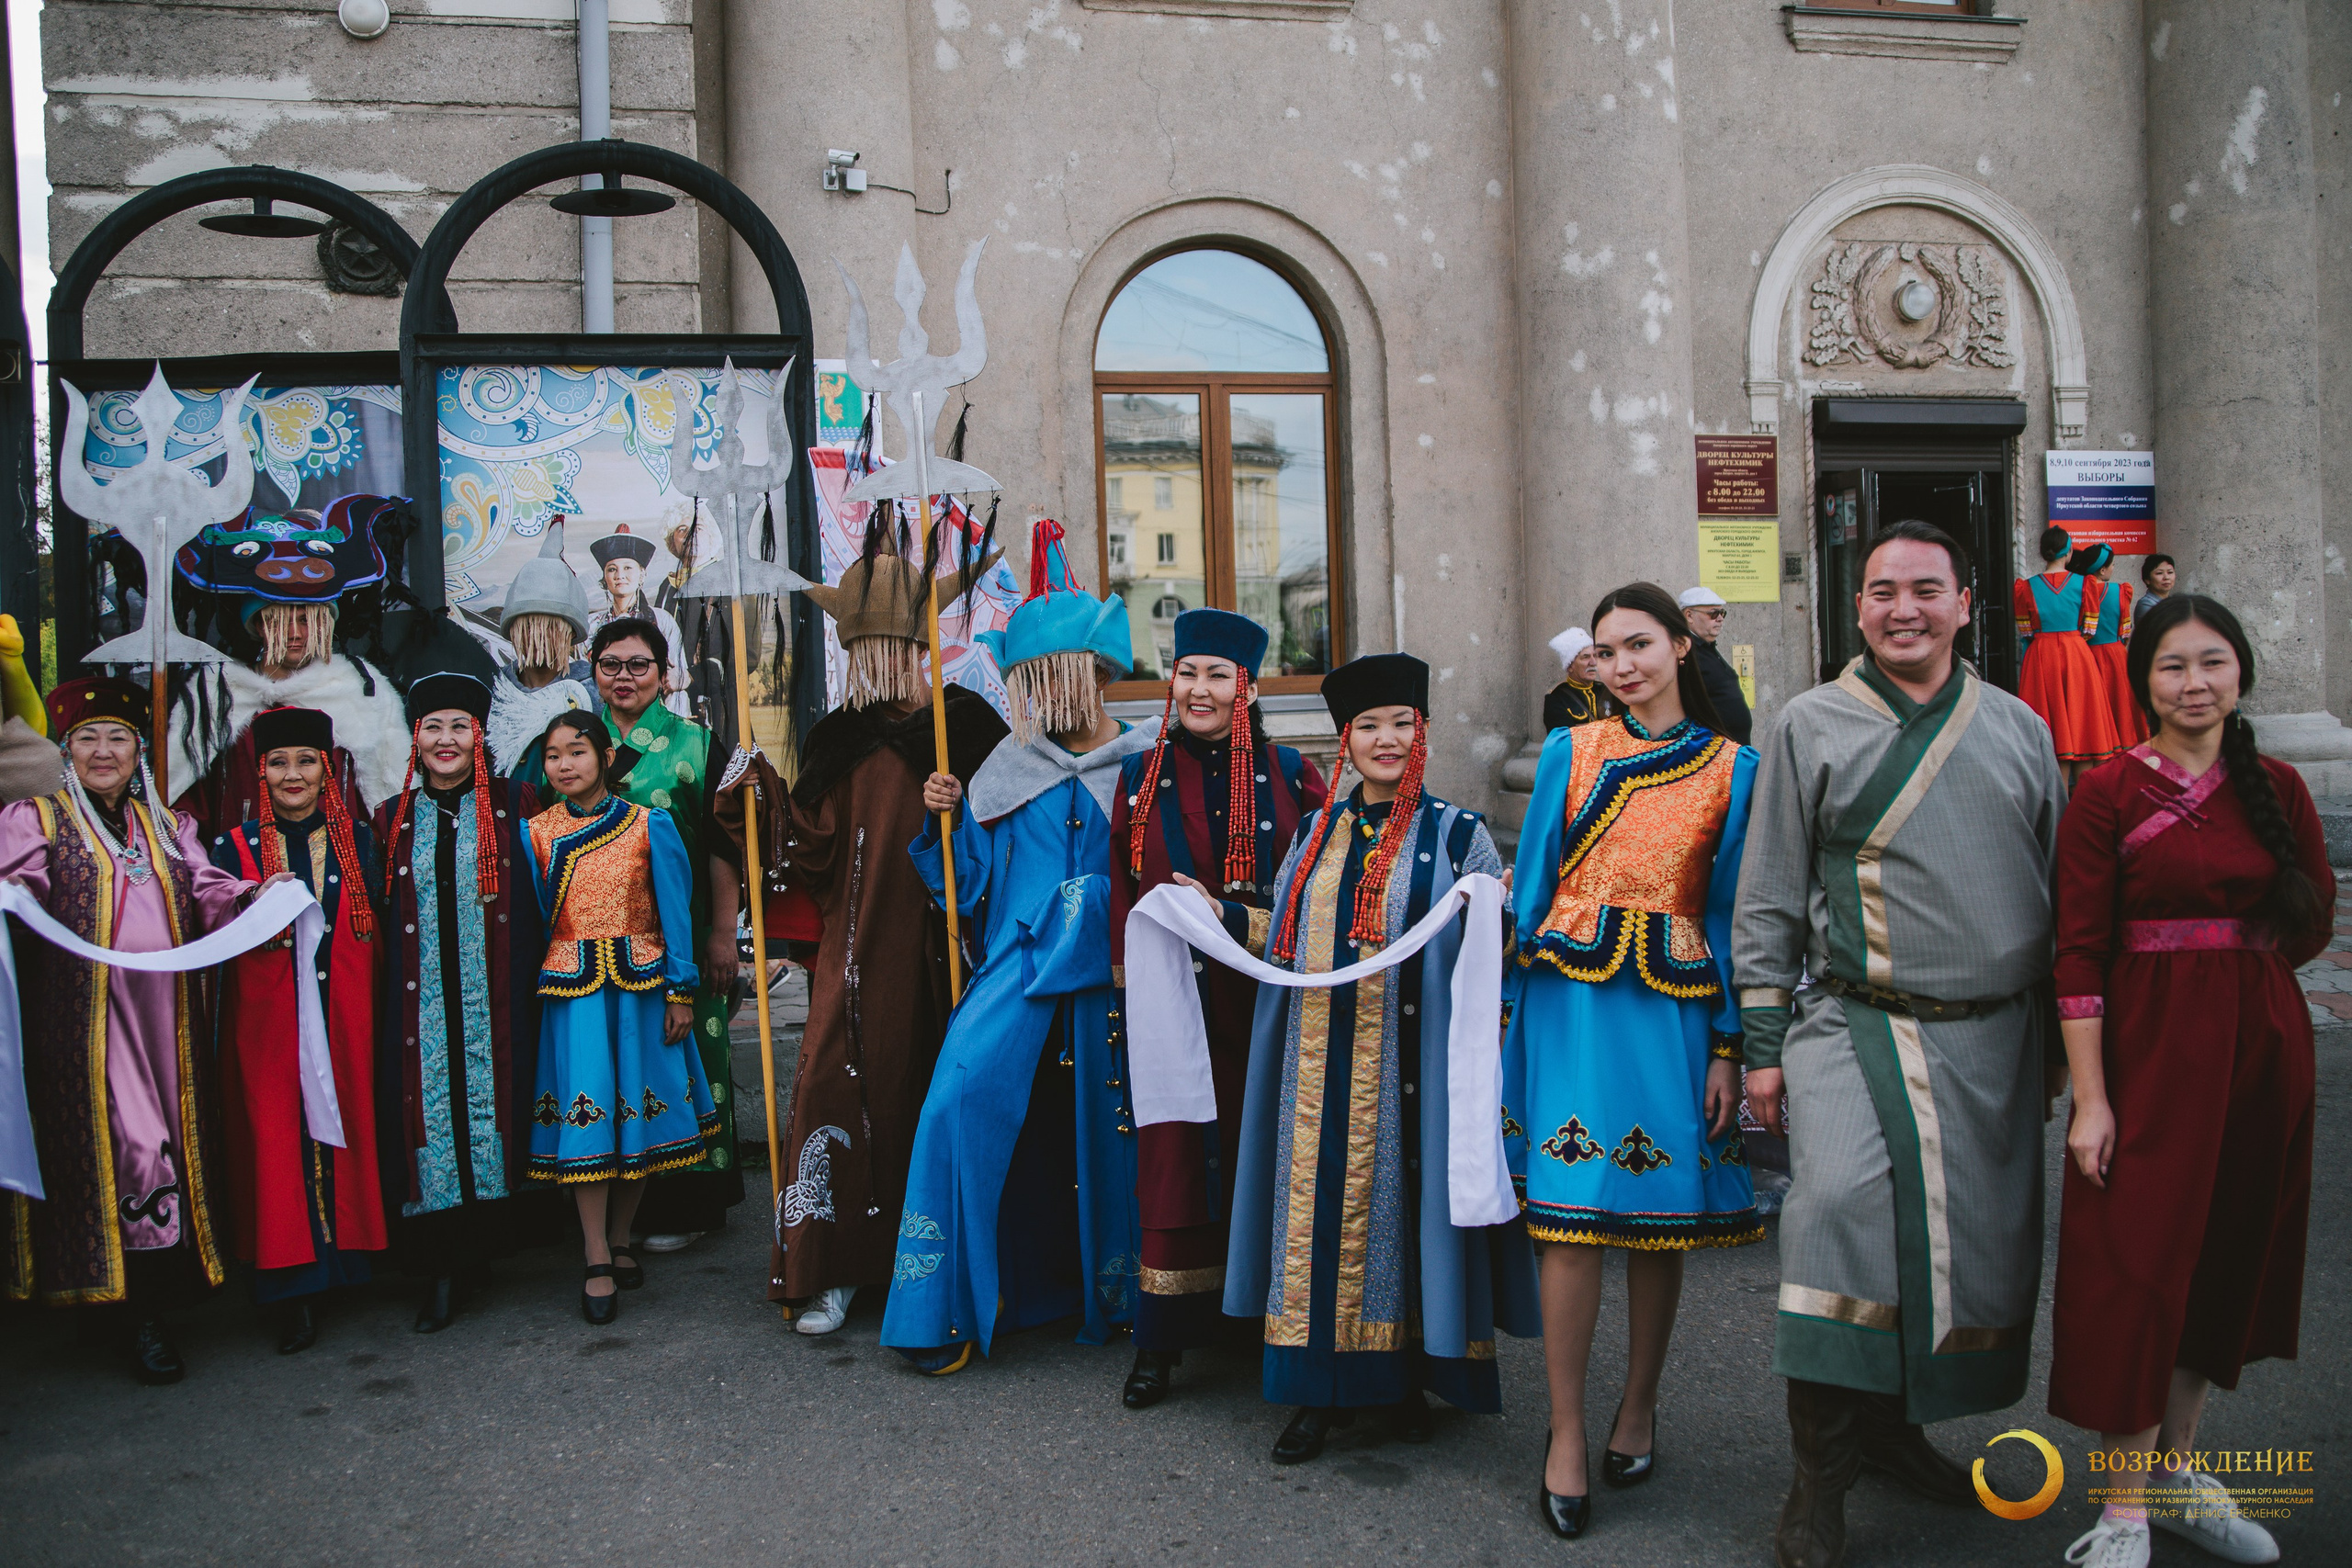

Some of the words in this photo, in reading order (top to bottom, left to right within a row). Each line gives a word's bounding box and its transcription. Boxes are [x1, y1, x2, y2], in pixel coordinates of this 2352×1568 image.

[1697, 451, 1729, 459] ДВОРЕЦ
[1731, 451, 1774, 459] КУЛЬТУРЫ
[2050, 458, 2073, 468] 8,9,10
[2075, 458, 2112, 469] сентября
[2114, 458, 2132, 468] 2023
[2077, 472, 2125, 482] ВЫБОРЫ
[1713, 479, 1732, 487] Часы
[1733, 479, 1759, 488] работы:
[1713, 488, 1731, 496] 8.00
[1743, 488, 1765, 496] 22.00
